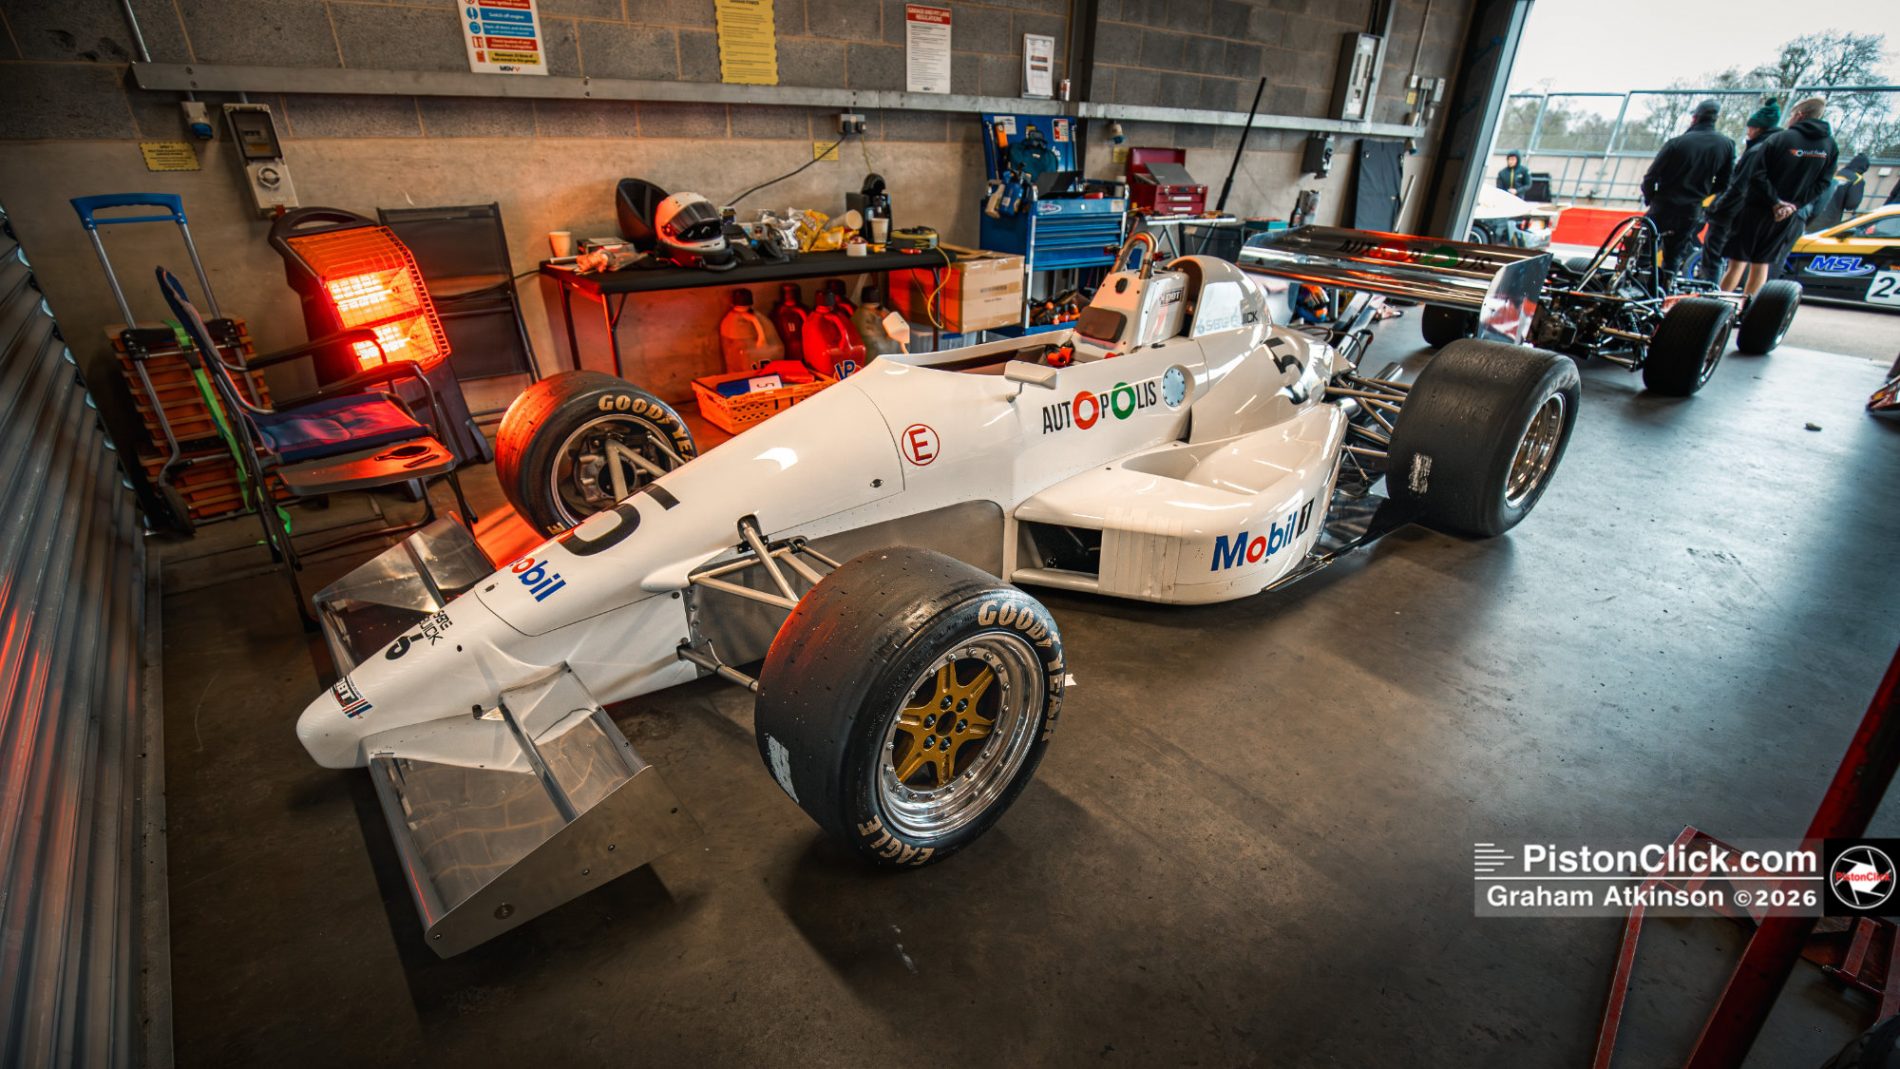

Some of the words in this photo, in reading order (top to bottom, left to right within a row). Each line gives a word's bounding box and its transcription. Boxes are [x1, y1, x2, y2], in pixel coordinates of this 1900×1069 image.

[1808, 254, 1863, 272] MSL
[1260, 337, 1309, 405] 5
[1043, 381, 1157, 435] AUTOPOLIS
[908, 428, 933, 462] E
[1211, 511, 1298, 572] Mobil
[1296, 497, 1315, 539] 1
[511, 557, 567, 602] obil
[857, 814, 935, 866] EAGLE
